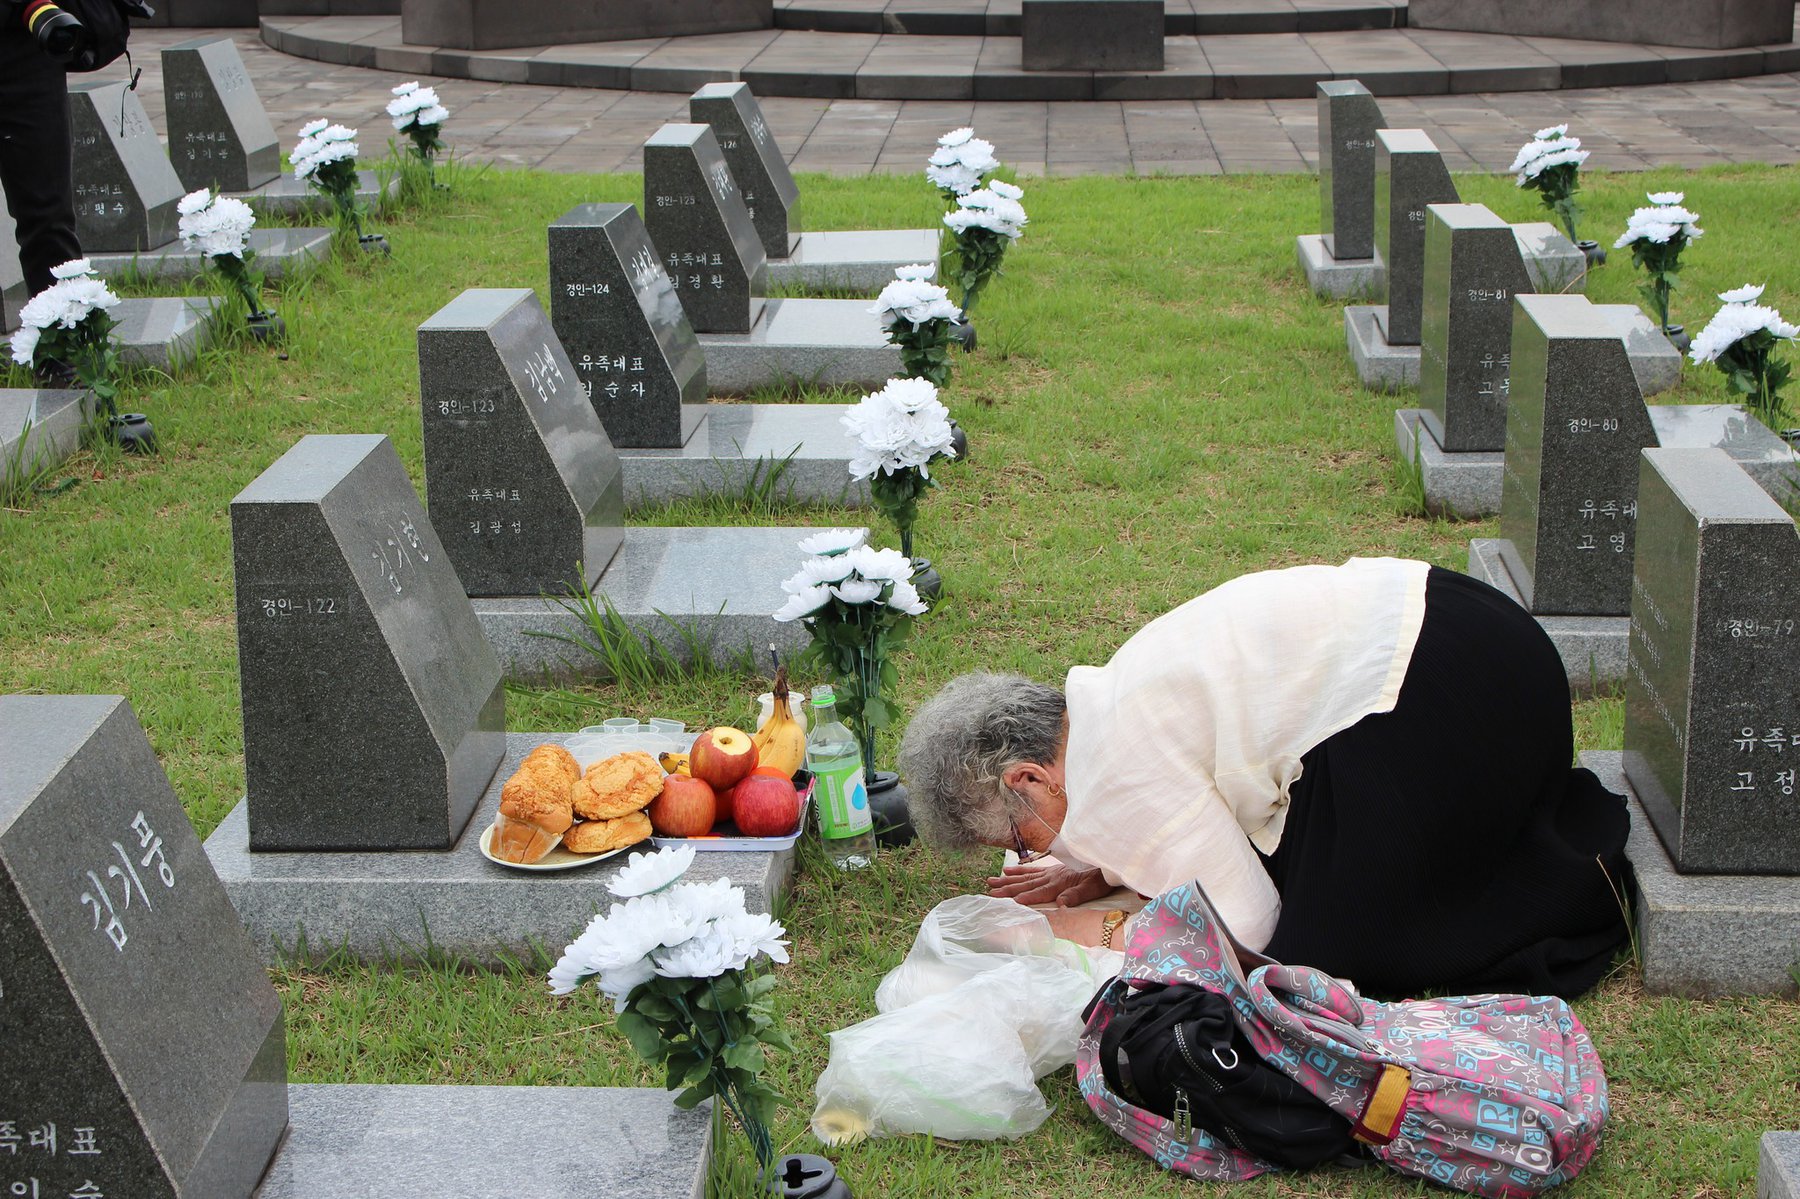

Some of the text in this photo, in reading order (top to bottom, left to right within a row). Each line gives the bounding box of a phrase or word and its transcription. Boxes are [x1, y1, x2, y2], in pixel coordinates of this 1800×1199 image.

[185, 131, 227, 143] 유족대표
[719, 140, 737, 149] -126
[76, 183, 123, 196] 유족대표
[656, 195, 696, 207] 경인-125
[667, 252, 723, 267] 유족대표
[566, 283, 610, 297] 경인-124
[1468, 289, 1507, 302] 경인-81
[578, 354, 645, 372] 유족대표
[1480, 352, 1510, 370] 유족
[438, 399, 495, 415] 경인-123
[1567, 417, 1618, 433] 경인-80
[467, 488, 521, 502] 유족대표
[1578, 499, 1638, 520] 유족대
[262, 597, 336, 618] 경인-122
[1729, 619, 1795, 638] 경인-79
[1733, 726, 1800, 753] 유족
[0, 1120, 102, 1157] 족대표
